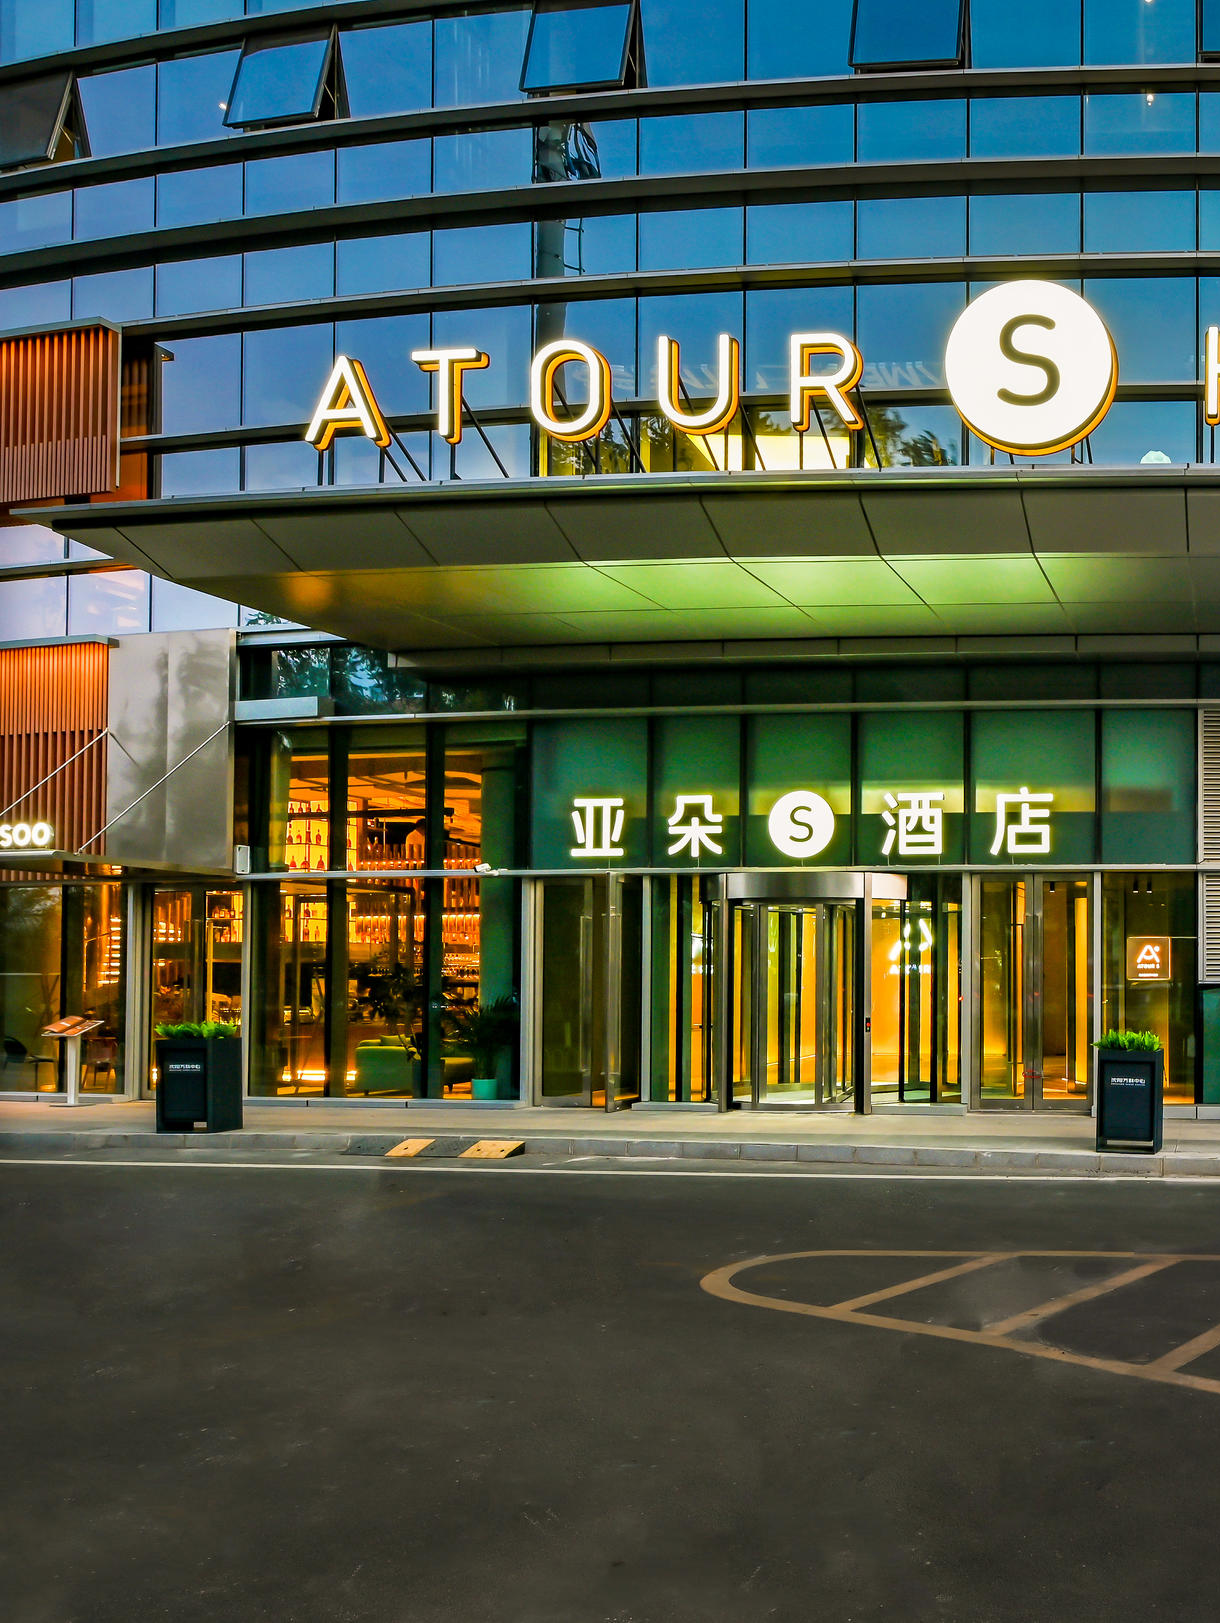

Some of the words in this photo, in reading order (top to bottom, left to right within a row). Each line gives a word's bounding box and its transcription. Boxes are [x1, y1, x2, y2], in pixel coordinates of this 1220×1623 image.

[305, 332, 864, 450] ATOUR
[570, 793, 724, 858] 亚朵
[881, 786, 1055, 857] 酒店
